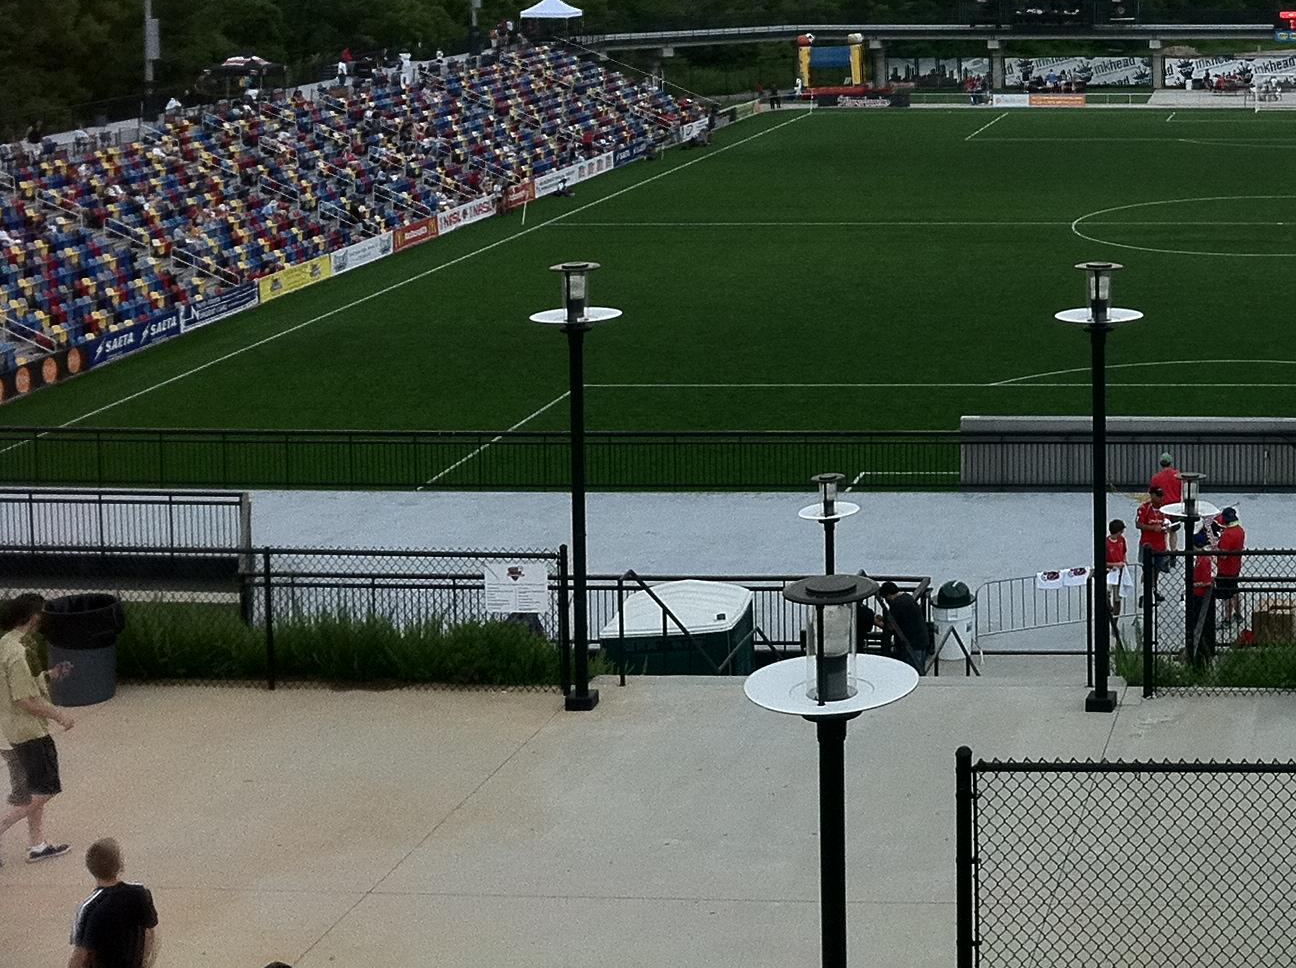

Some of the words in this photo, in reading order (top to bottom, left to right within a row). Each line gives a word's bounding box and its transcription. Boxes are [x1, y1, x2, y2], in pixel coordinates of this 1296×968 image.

[1094, 56, 1137, 75] inkhead
[1253, 56, 1296, 74] inkhead
[150, 315, 178, 336] SAETA
[105, 332, 135, 354] SAETA
